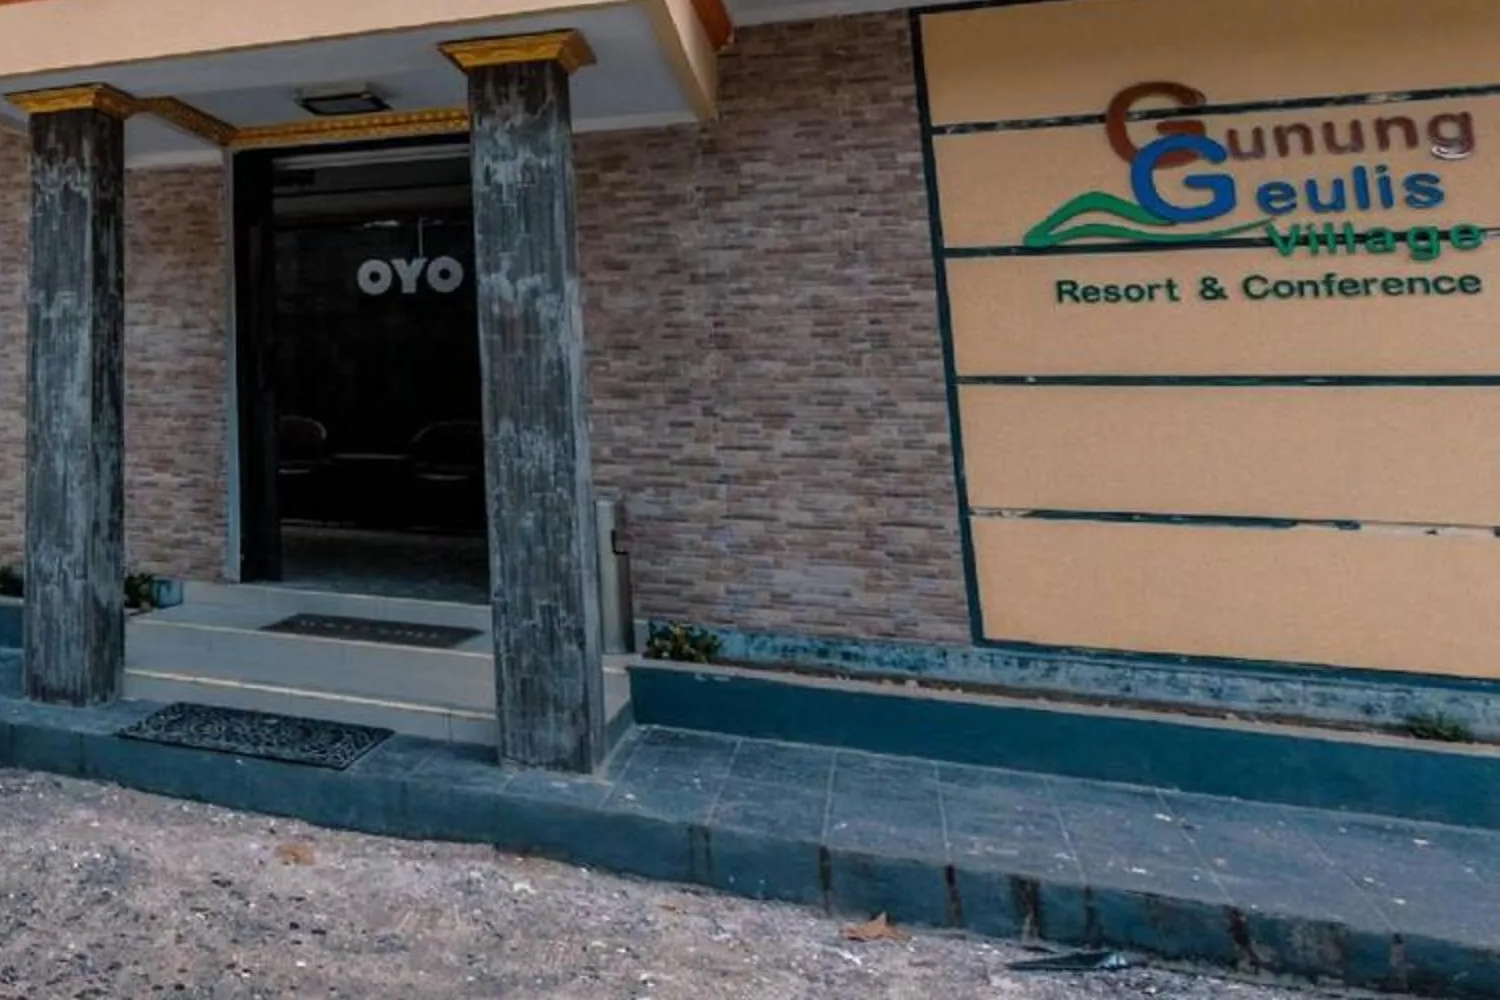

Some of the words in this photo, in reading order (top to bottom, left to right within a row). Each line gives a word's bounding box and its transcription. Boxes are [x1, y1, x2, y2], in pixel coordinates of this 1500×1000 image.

[1107, 81, 1475, 168] Gunung
[1131, 133, 1446, 223] Geulis
[1266, 222, 1483, 260] Village
[357, 255, 463, 295] OYO
[1055, 277, 1181, 305] Resort
[1200, 277, 1228, 300] &
[1242, 273, 1482, 300] Conference
